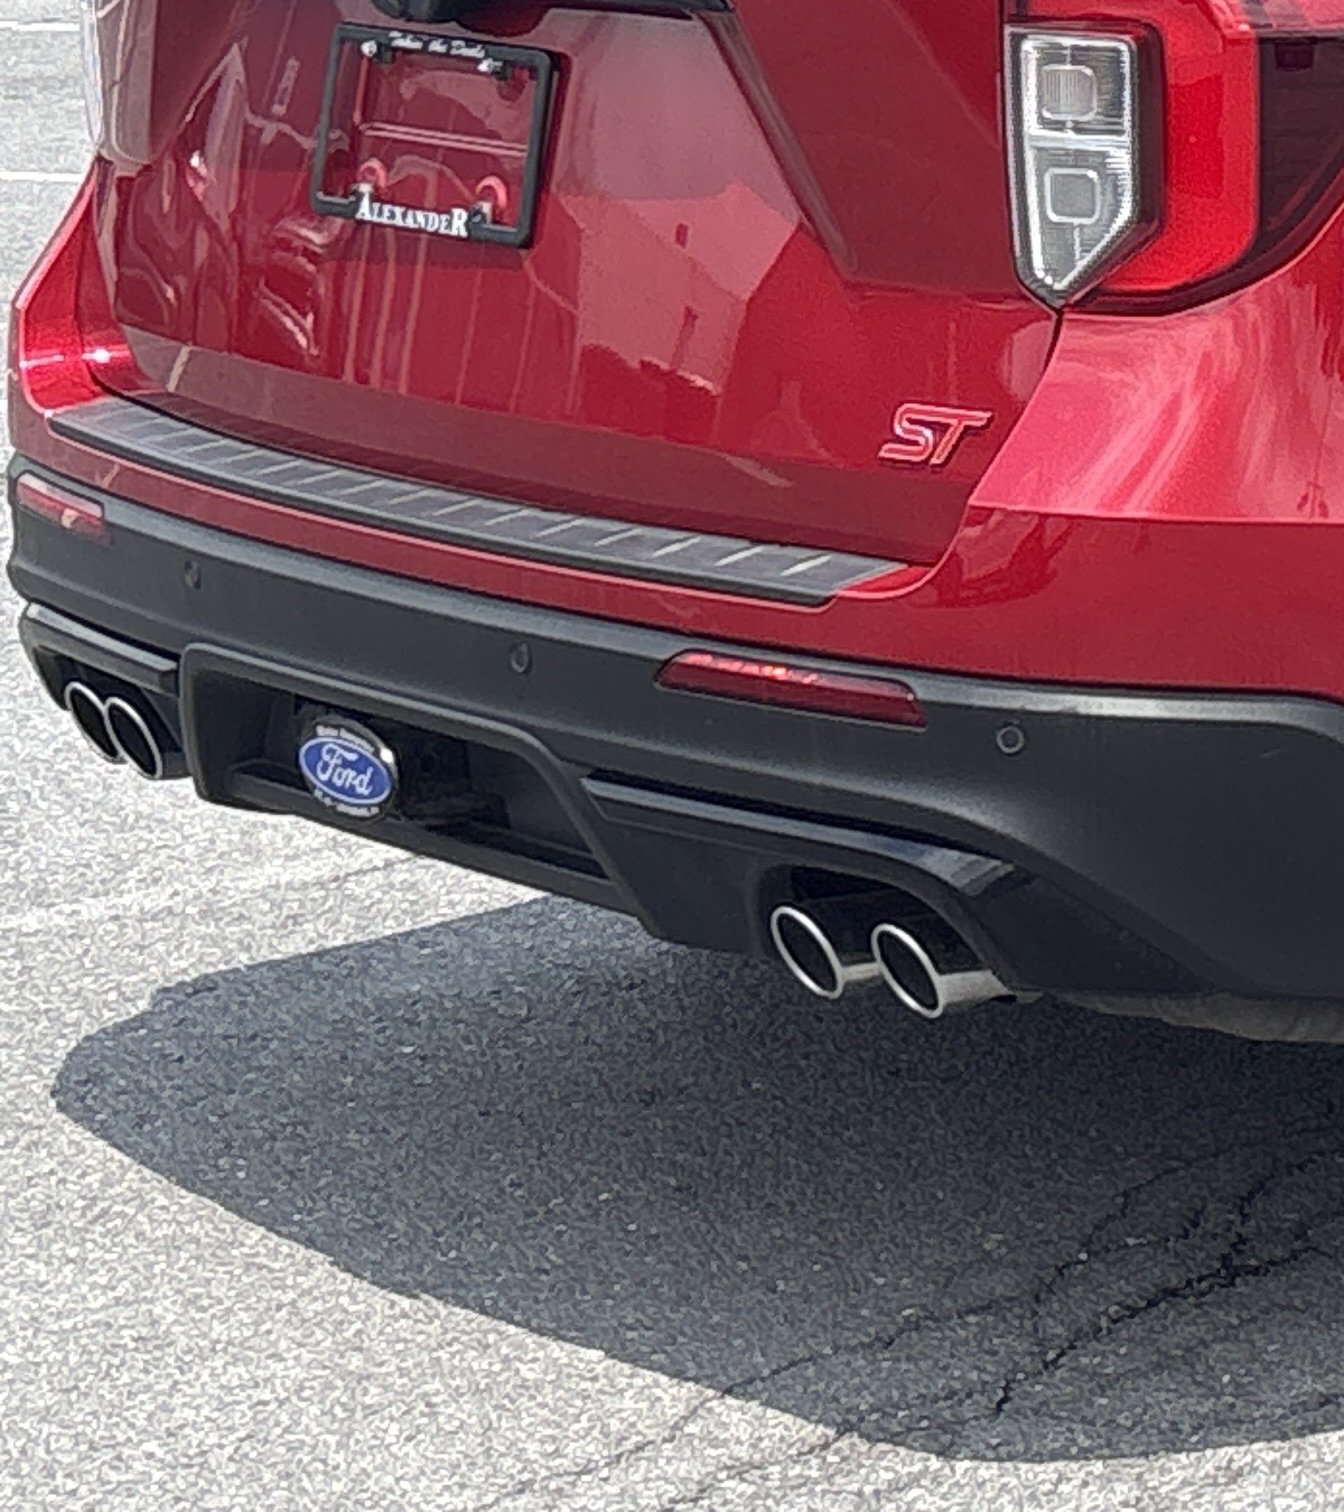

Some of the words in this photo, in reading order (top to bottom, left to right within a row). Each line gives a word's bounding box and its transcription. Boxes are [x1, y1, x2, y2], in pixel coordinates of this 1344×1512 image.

[354, 191, 469, 238] ALEXANDER
[878, 402, 993, 465] ST
[315, 742, 375, 797] Ford
